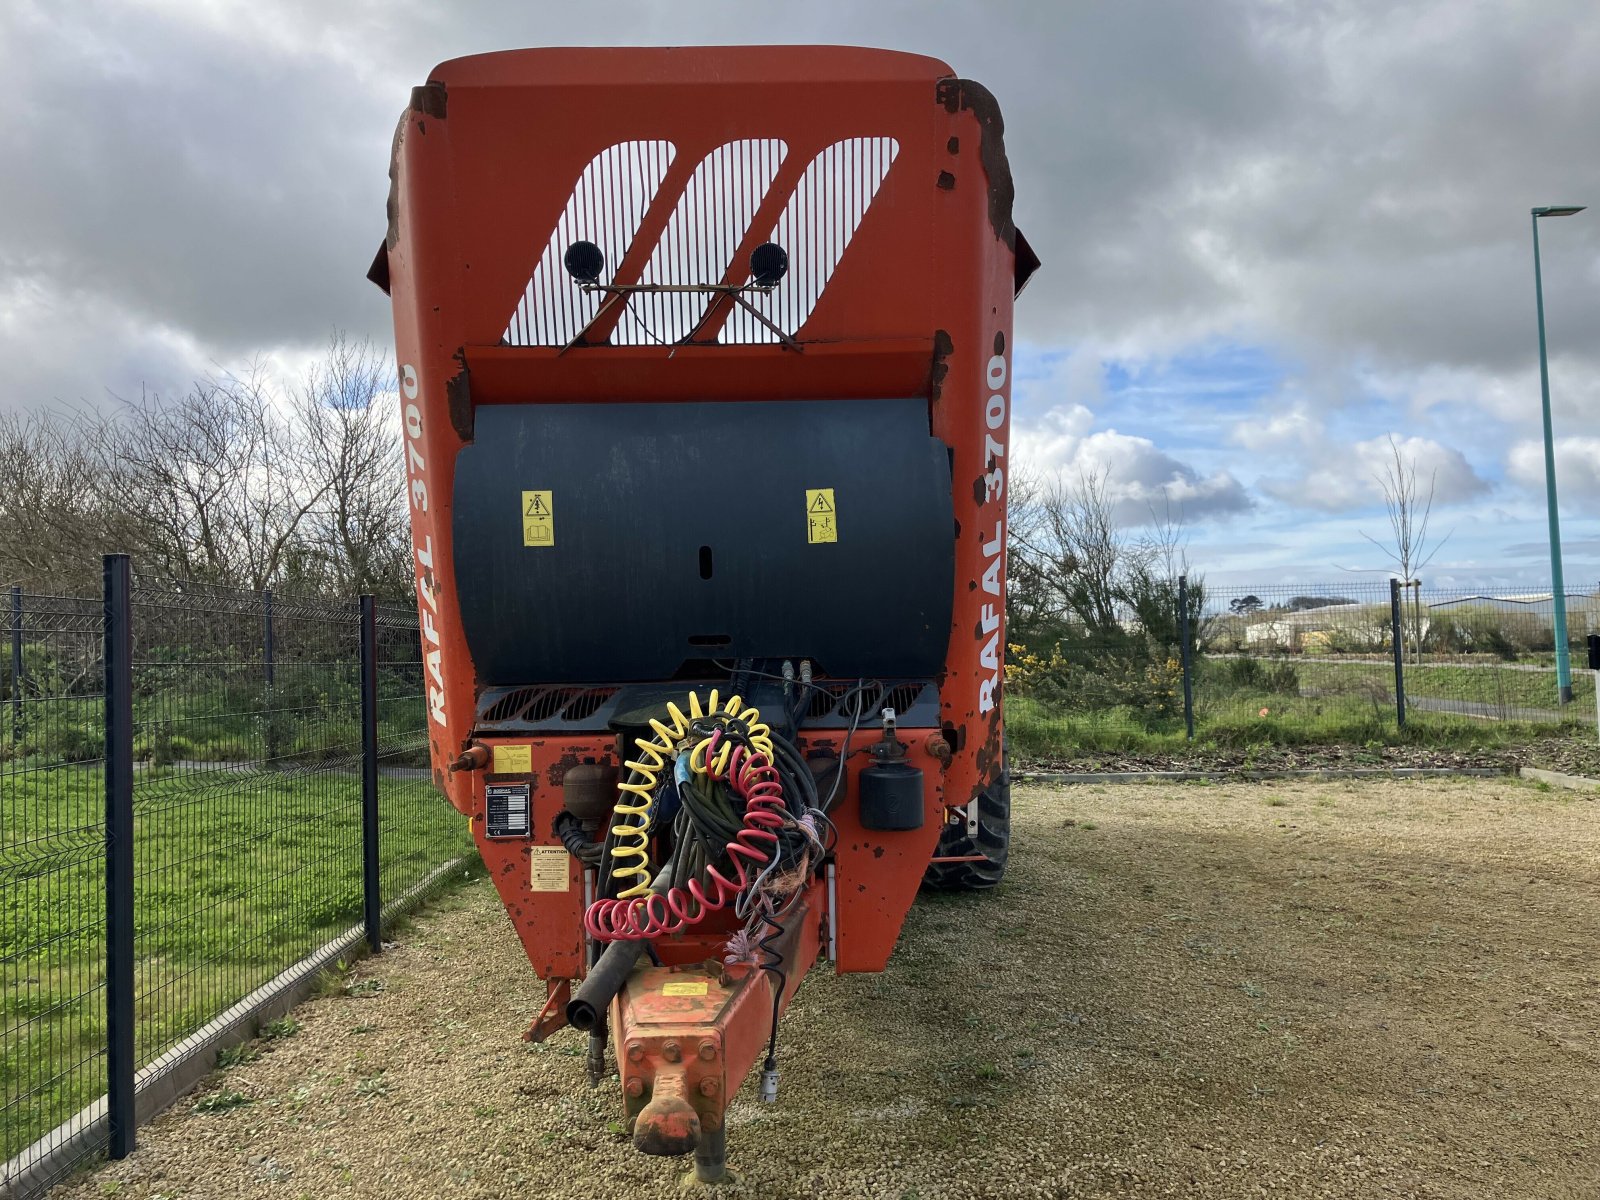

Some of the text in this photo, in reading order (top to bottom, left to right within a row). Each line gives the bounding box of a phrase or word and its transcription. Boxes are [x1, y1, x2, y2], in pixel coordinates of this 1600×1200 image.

[403, 363, 448, 728] RAFAL 3700
[979, 354, 1007, 714] RAFAL 3700
